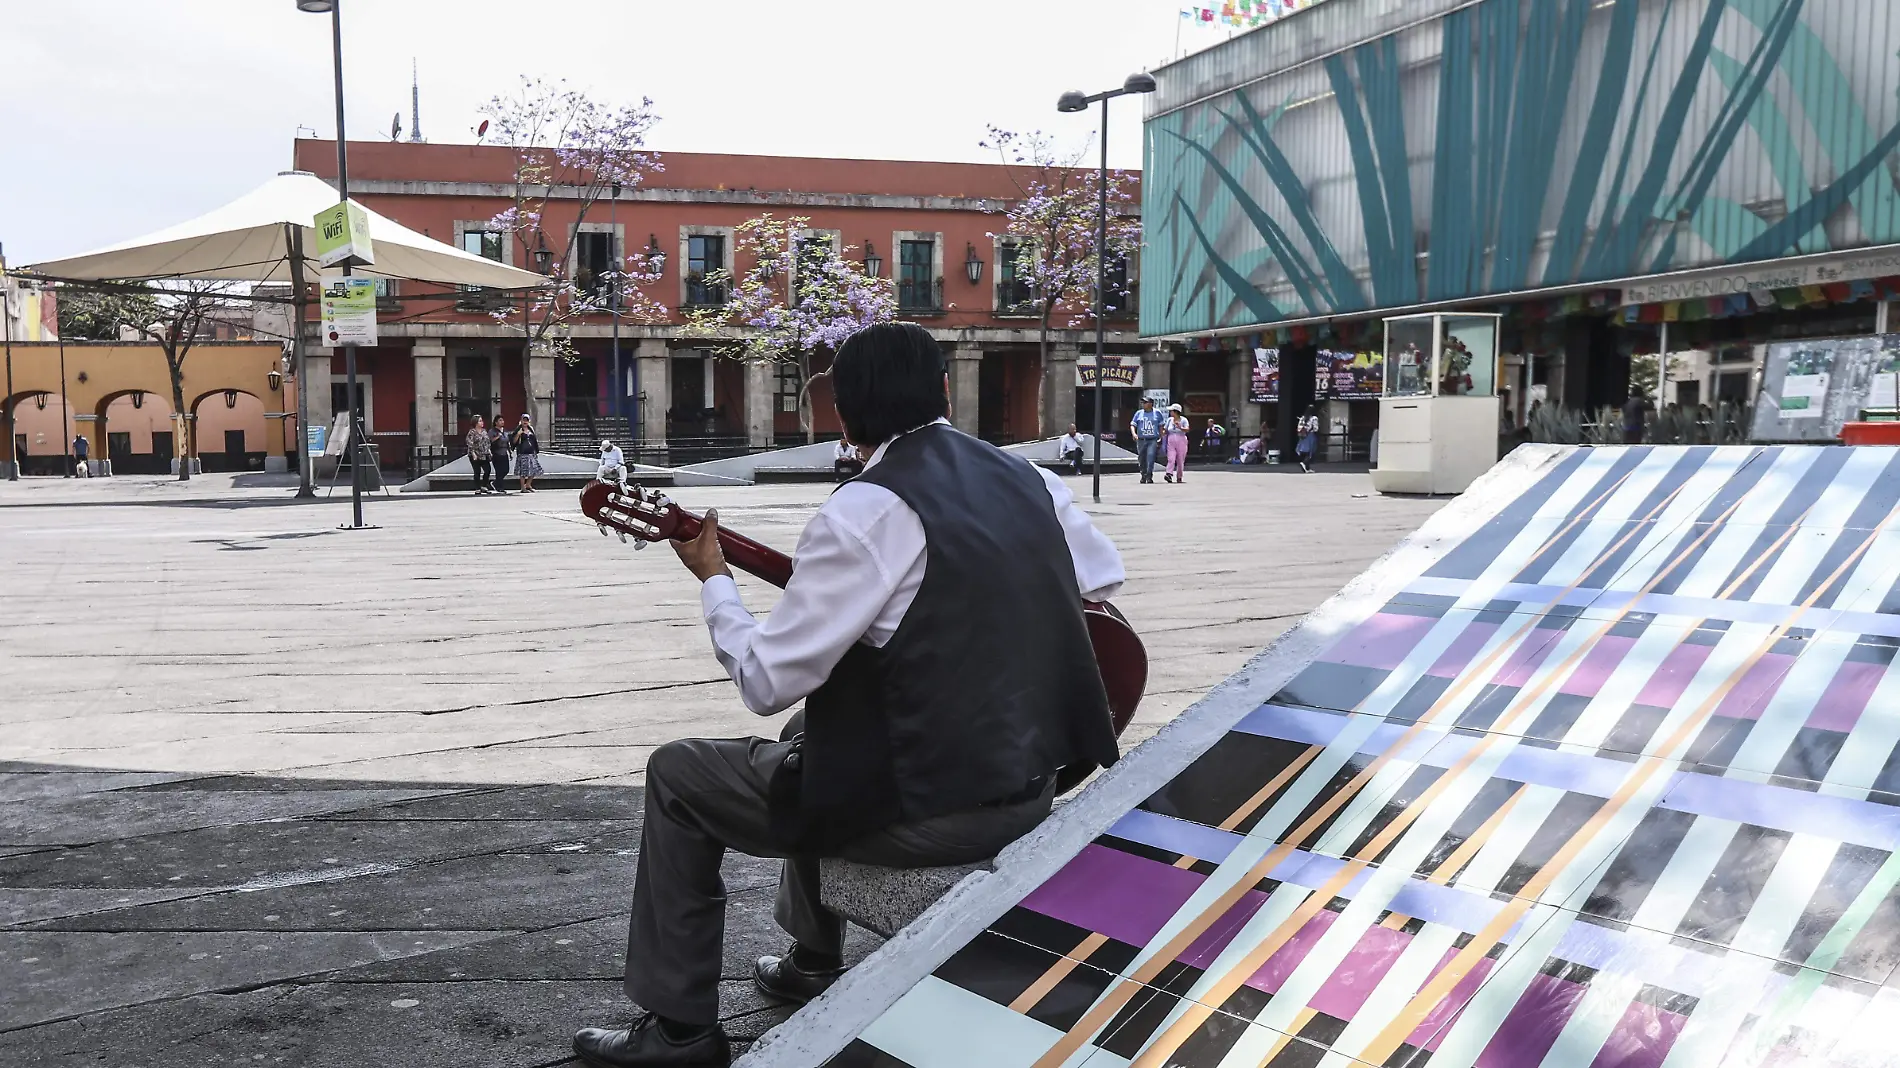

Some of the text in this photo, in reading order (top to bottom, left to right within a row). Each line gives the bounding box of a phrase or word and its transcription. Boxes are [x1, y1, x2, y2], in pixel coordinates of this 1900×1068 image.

[323, 220, 343, 240] WiFi
[1648, 276, 1747, 301] BIENVENIDO
[1747, 276, 1800, 290] BIENVENUE
[1083, 367, 1133, 381] TRPICANA
[1315, 379, 1328, 390] 16
